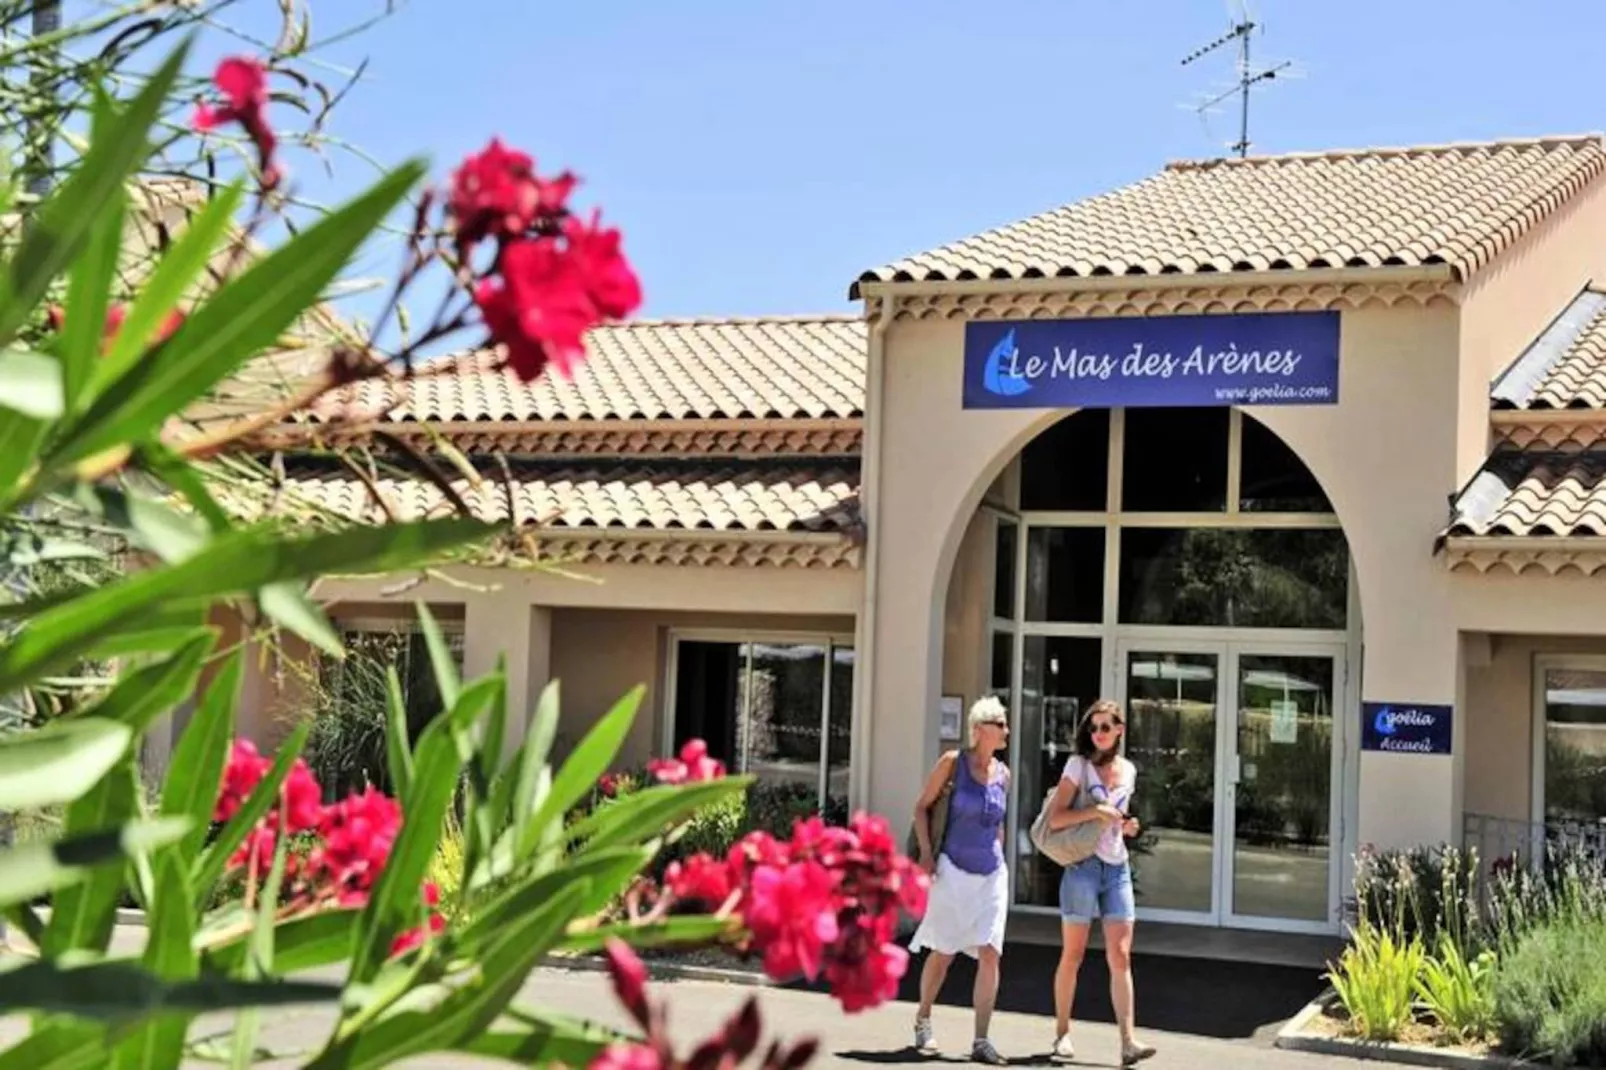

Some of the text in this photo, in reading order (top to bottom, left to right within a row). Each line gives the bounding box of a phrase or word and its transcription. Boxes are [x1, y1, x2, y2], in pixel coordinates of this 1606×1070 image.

[1009, 341, 1302, 380] Le Mas des Arènes
[1215, 383, 1330, 402] www.goelia.com
[1380, 737, 1432, 752] Accueil
